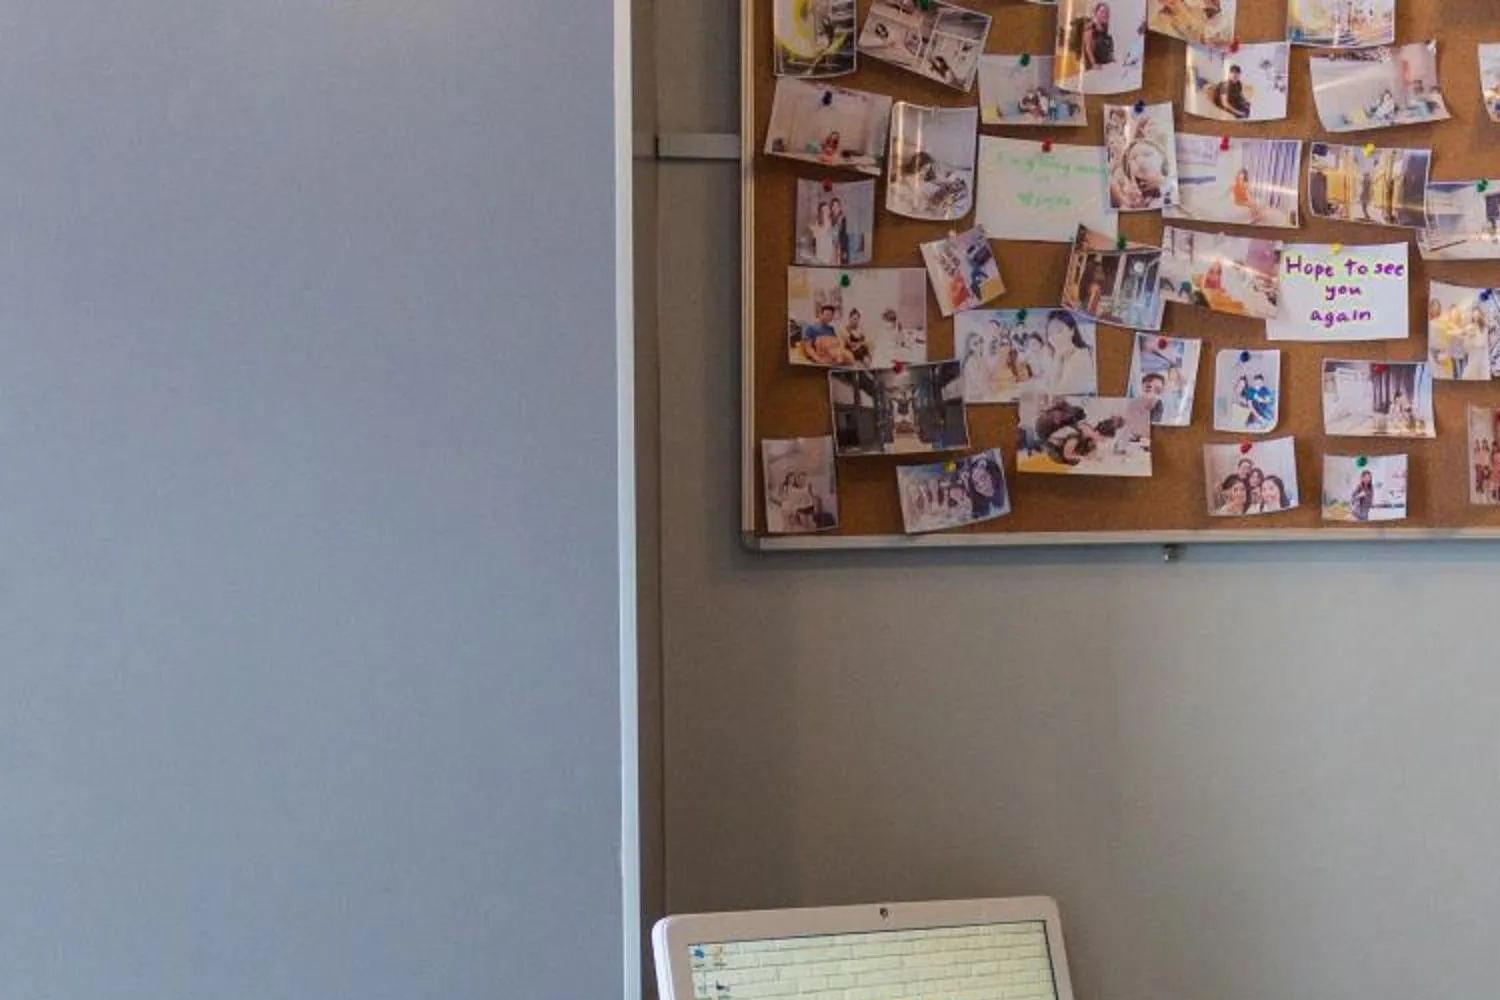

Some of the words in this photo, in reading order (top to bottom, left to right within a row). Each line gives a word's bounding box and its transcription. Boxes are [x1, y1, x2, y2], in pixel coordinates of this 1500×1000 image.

[1285, 255, 1334, 280] Hope
[1373, 263, 1405, 276] see
[1325, 284, 1363, 301] you
[1310, 308, 1372, 328] again
